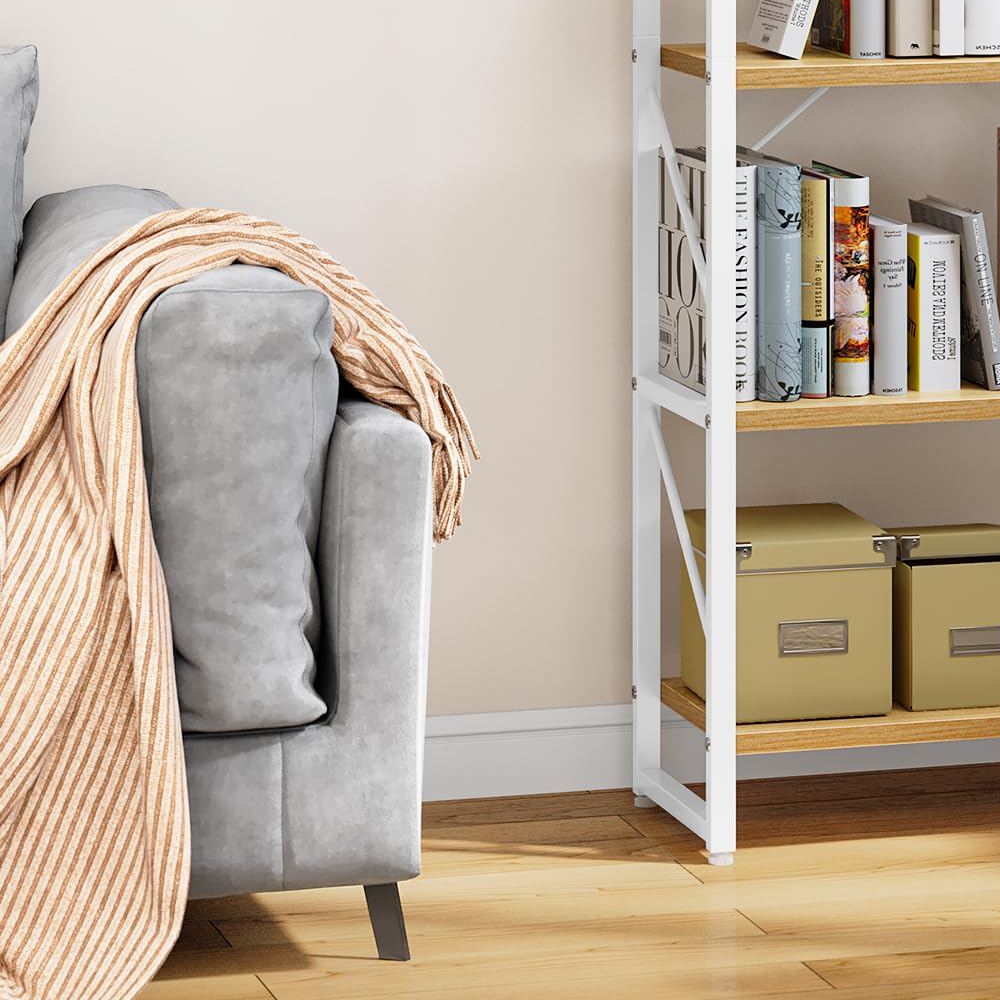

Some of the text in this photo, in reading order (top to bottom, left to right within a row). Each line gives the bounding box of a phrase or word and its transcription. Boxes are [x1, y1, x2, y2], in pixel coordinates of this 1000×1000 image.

[974, 253, 988, 274] ON
[814, 259, 824, 318] THE OUTSIDERS
[978, 276, 994, 306] LINE
